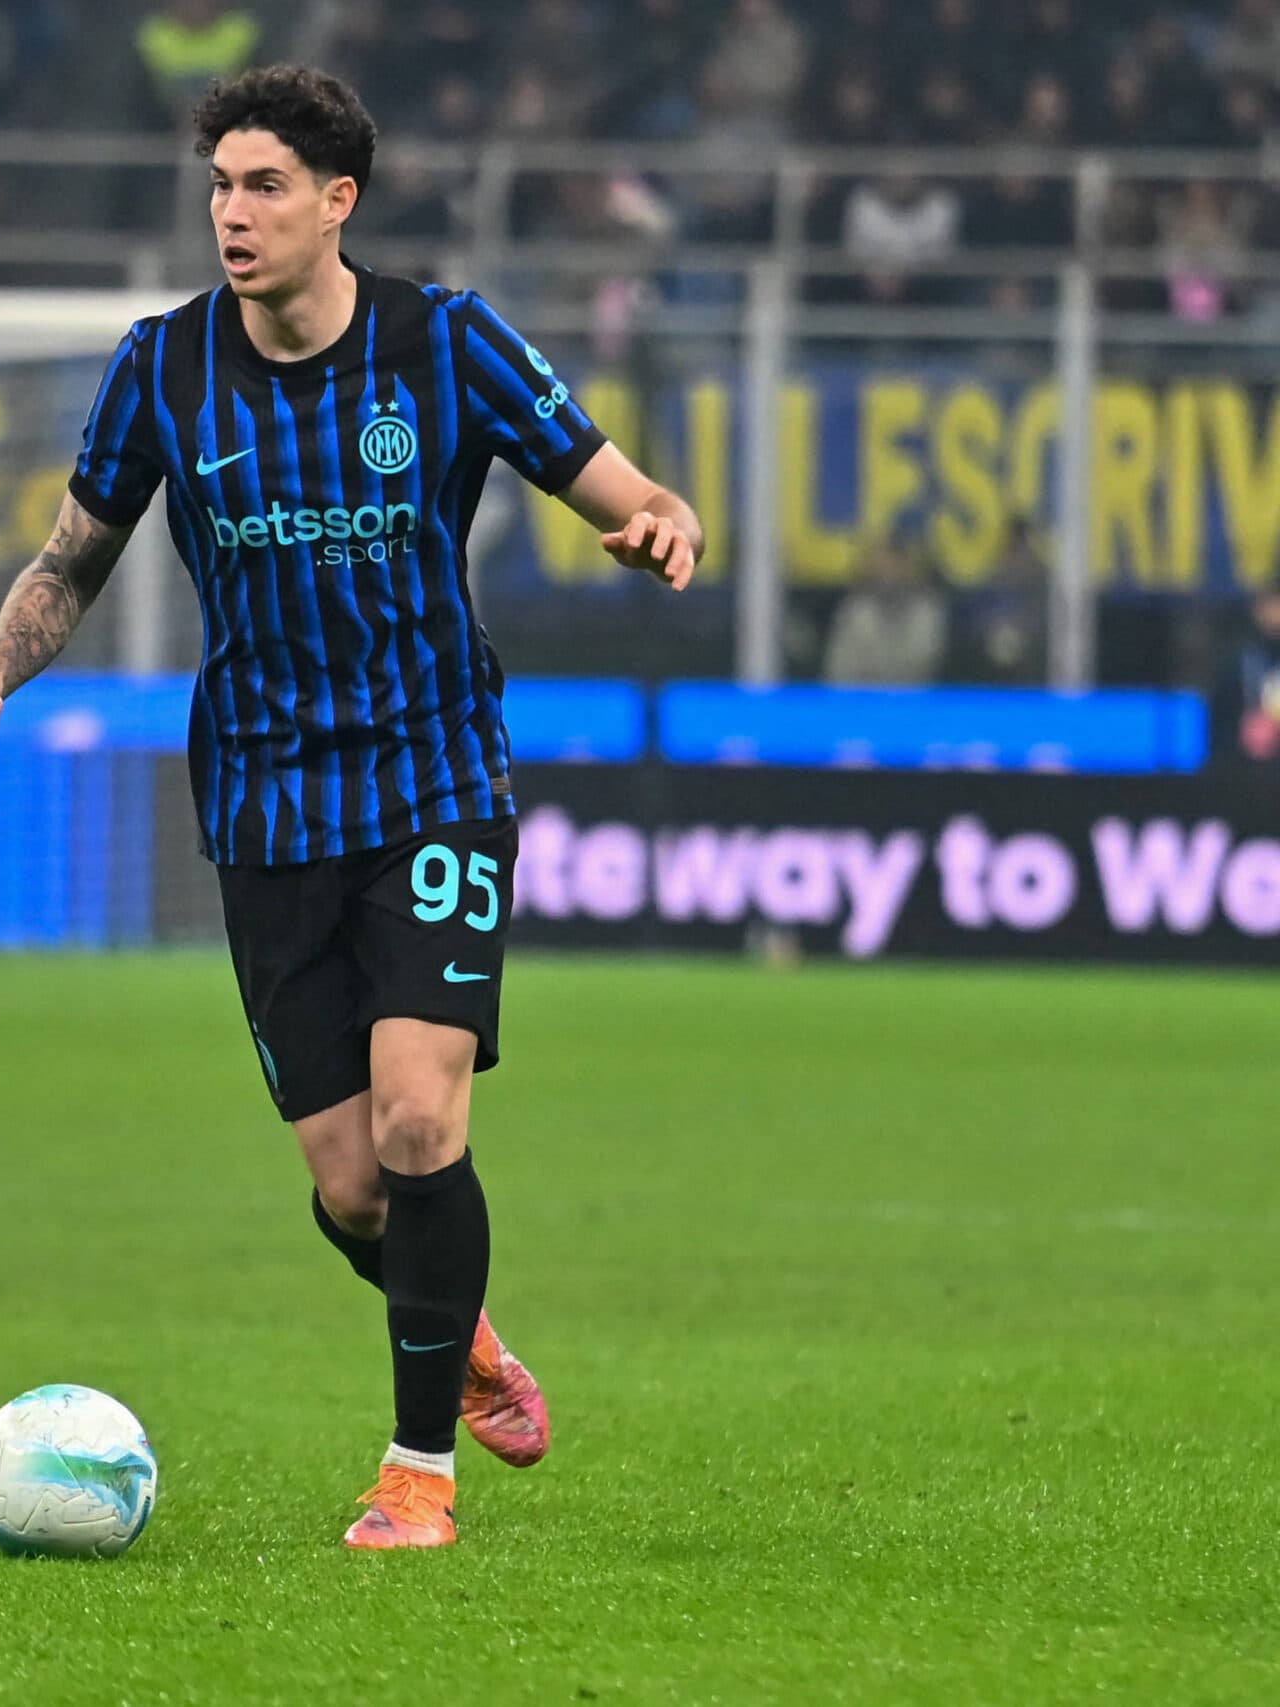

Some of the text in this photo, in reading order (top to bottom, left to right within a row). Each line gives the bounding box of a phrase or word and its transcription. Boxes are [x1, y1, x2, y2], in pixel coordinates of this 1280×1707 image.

[207, 501, 416, 548] betsson
[316, 532, 415, 568] .sport
[411, 843, 499, 932] 95
[513, 804, 920, 958] teway
[937, 814, 1076, 932] to
